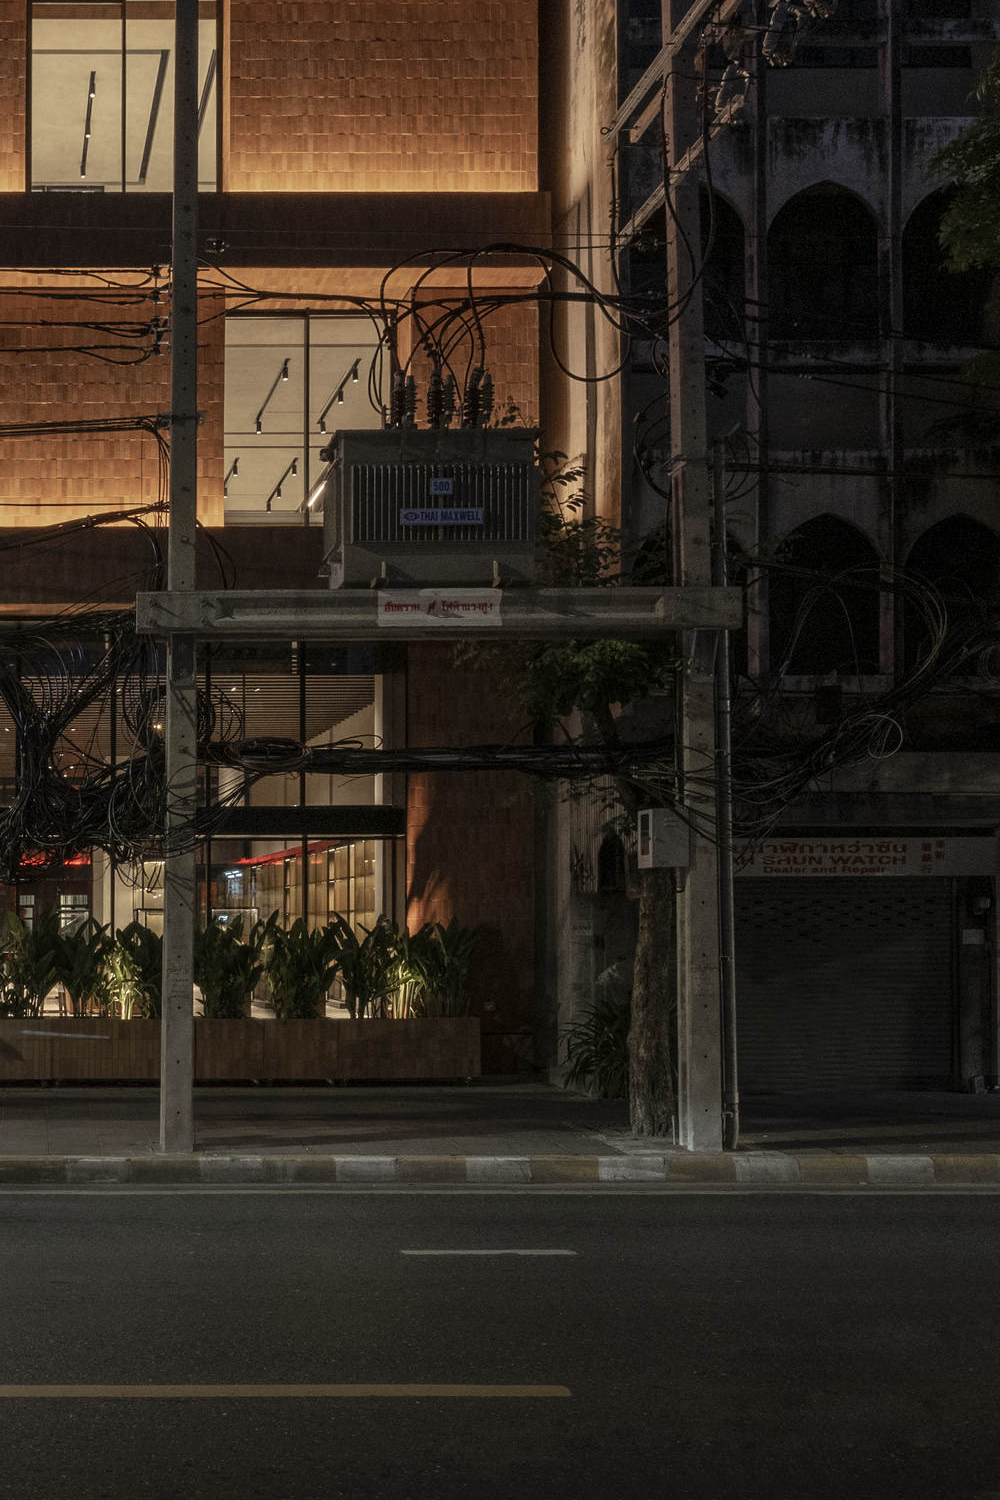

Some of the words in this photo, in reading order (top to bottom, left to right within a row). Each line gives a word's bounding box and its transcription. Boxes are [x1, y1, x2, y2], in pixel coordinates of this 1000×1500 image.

[433, 481, 450, 491] 500
[420, 511, 438, 521] THAI
[440, 510, 480, 521] MAXWELL
[384, 601, 420, 612] อันตราย
[441, 600, 493, 614] ไฟฟ้าแรงสูง
[762, 856, 822, 865] SHUN
[830, 856, 906, 865] WATCH
[763, 866, 807, 874] Dealer
[811, 866, 836, 874] and
[842, 866, 887, 875] Repair
